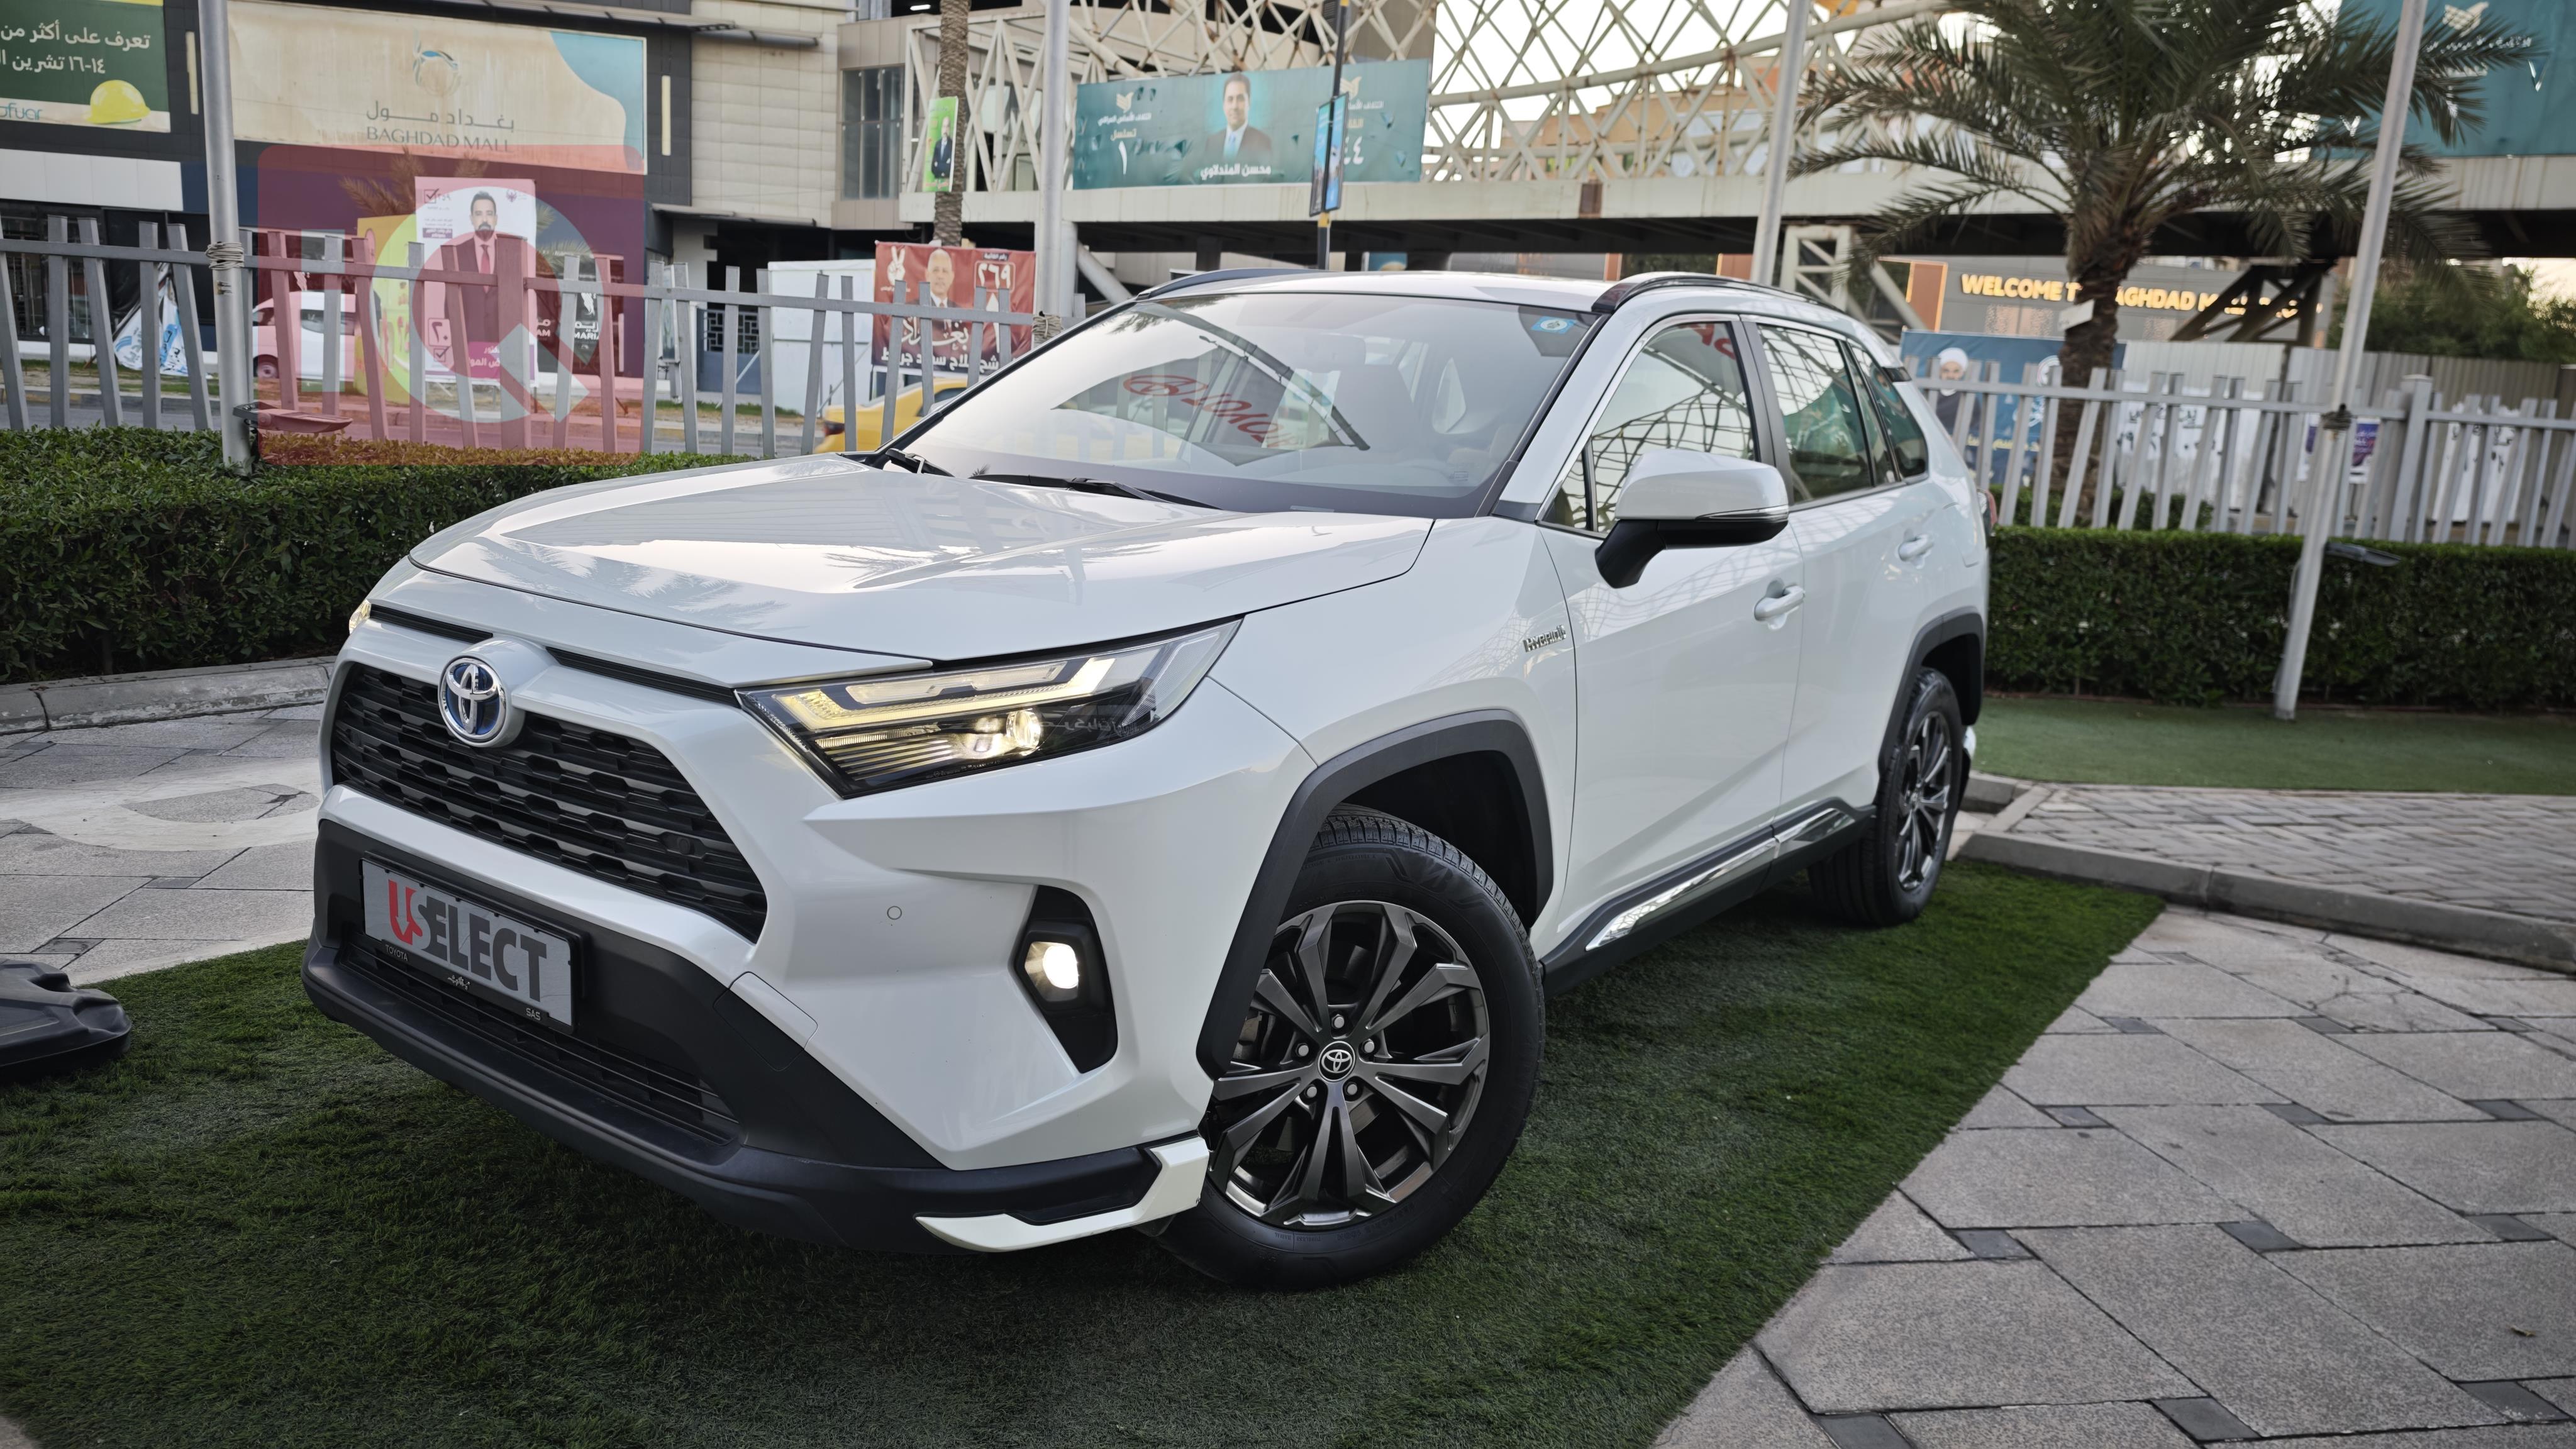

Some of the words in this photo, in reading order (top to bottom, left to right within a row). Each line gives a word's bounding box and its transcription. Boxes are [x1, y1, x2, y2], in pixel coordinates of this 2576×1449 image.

[1, 25, 25, 40] من
[30, 19, 60, 43] أكثر
[65, 27, 101, 44] على
[104, 31, 151, 52] تعرف
[13, 54, 65, 73] تشرين
[367, 100, 439, 121] مول
[447, 108, 514, 133] بغداد
[367, 126, 459, 148] BAGHDAD
[464, 135, 514, 153] MALL
[1241, 164, 1271, 177] محسن
[1961, 274, 2063, 301] WELCOME
[2115, 287, 2197, 311] AGHDAD
[1523, 625, 1566, 653] HYBRID
[385, 943, 408, 962] TOYOTA
[526, 1008, 541, 1021] SAS
